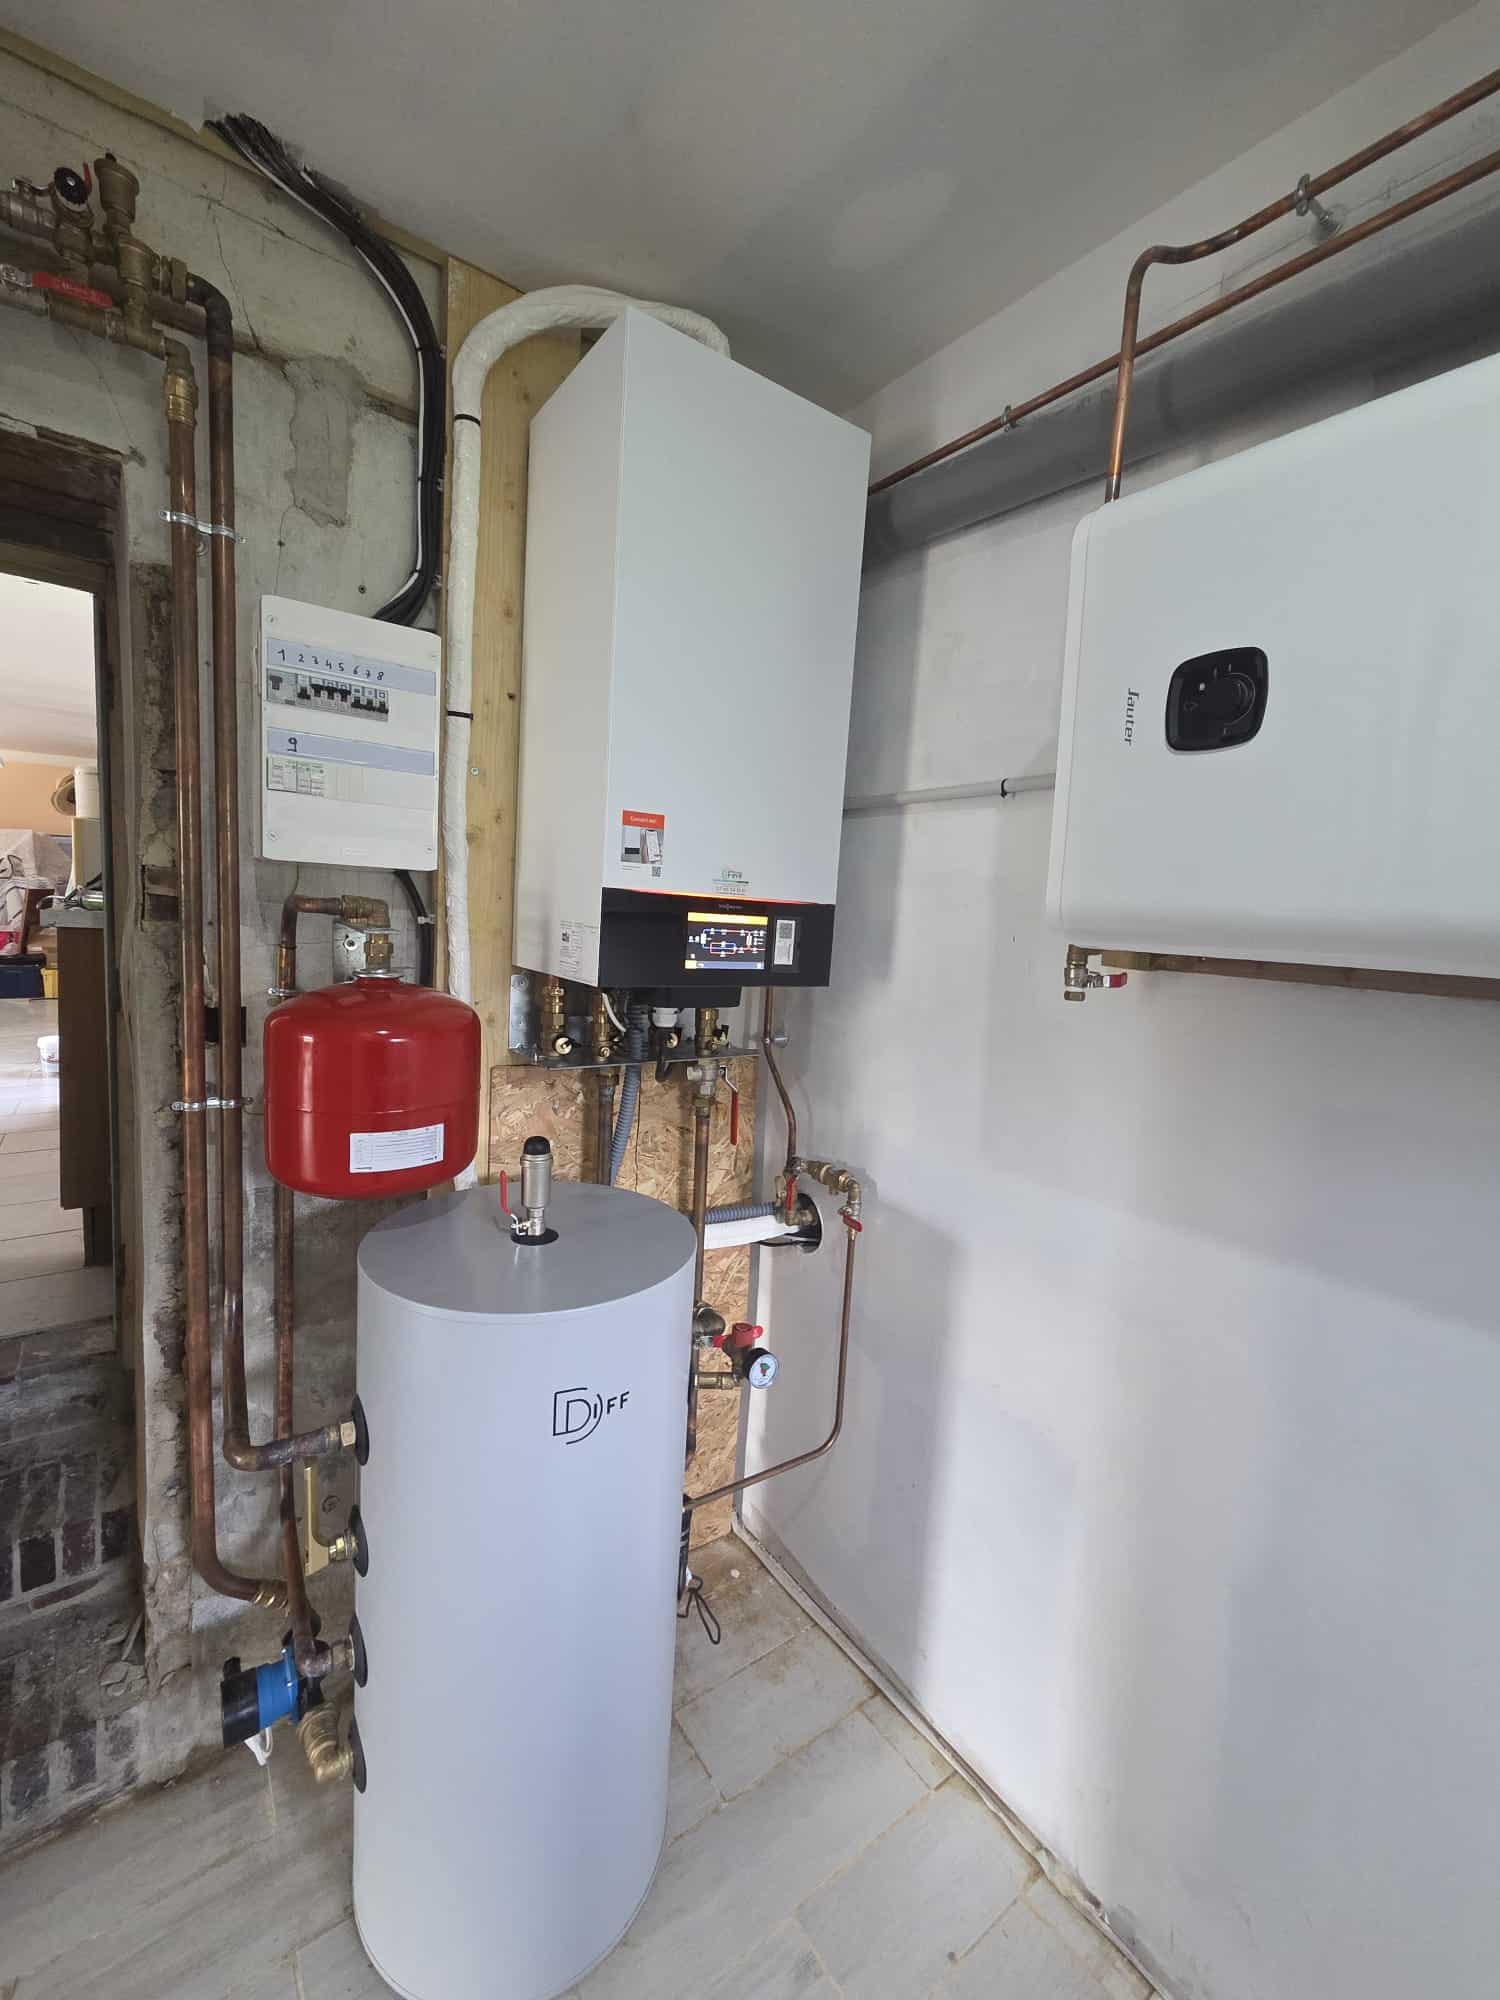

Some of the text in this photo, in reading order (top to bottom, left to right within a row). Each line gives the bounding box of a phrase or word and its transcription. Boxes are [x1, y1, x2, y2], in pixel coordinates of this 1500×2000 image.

[277, 648, 385, 681] 1 2 3 4 5 6 7 8
[287, 736, 298, 753] 9
